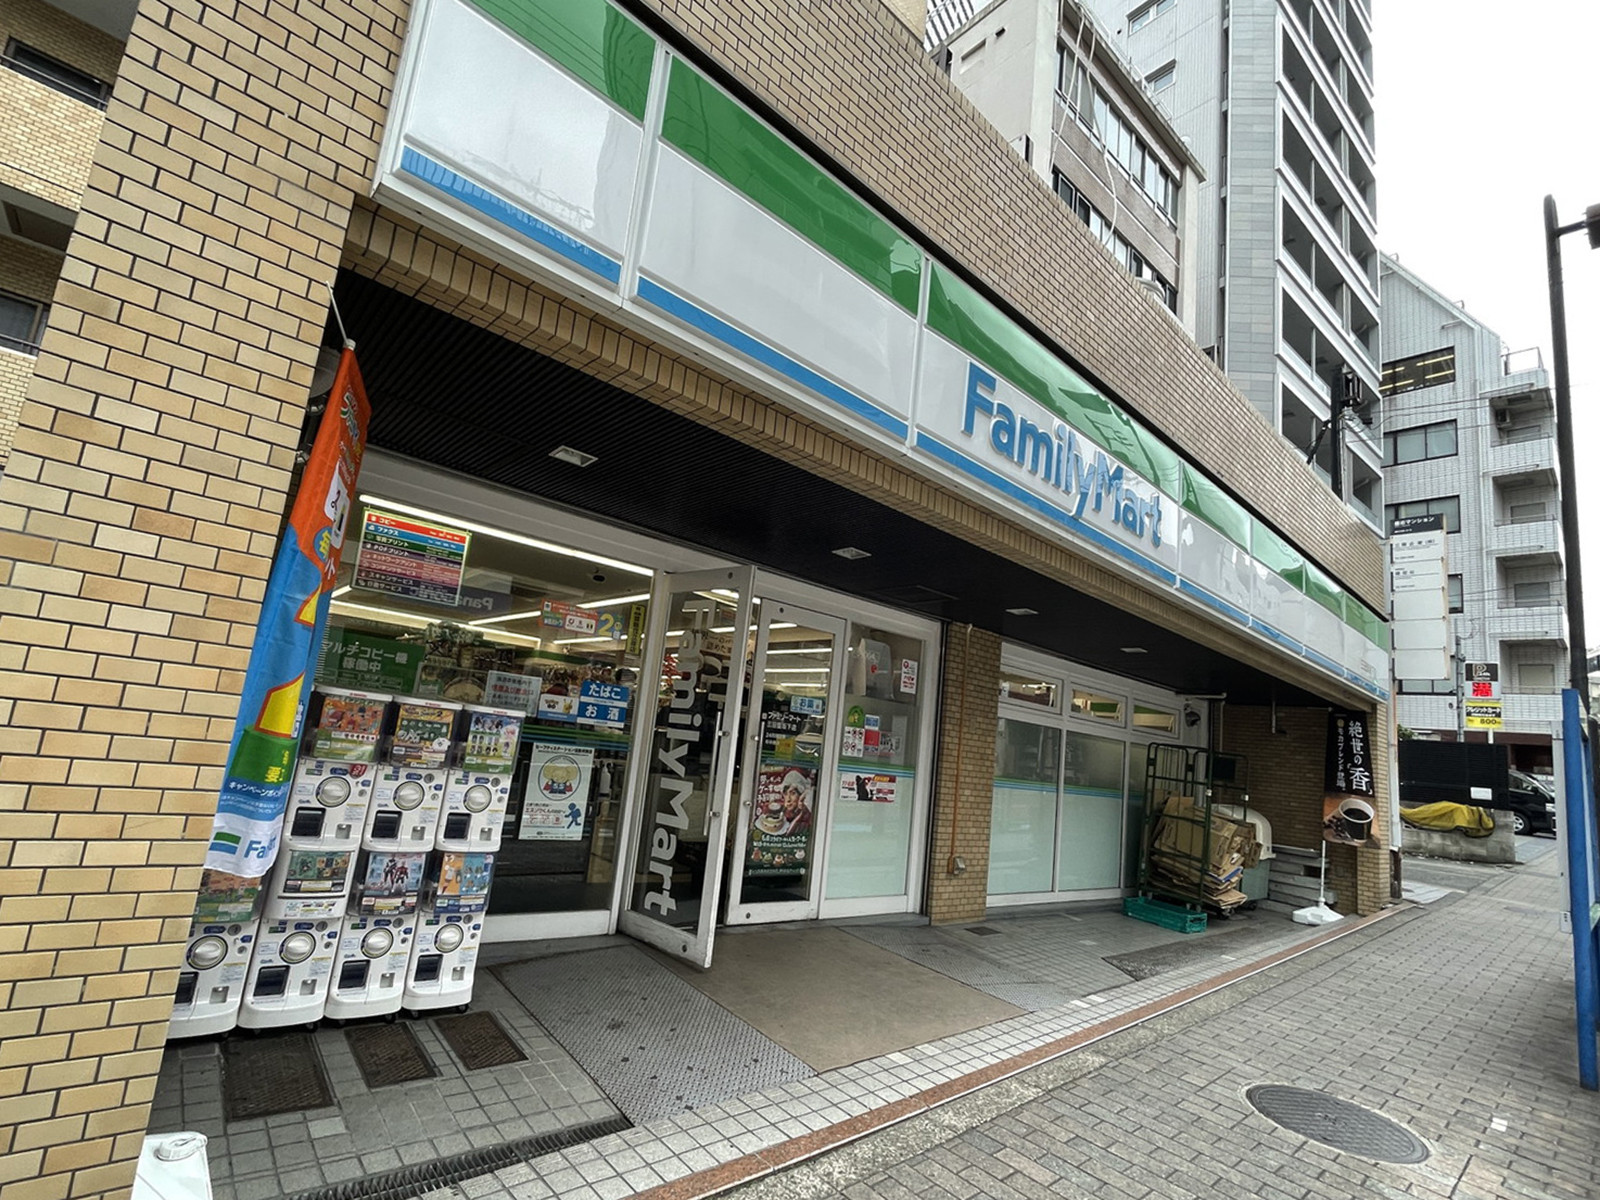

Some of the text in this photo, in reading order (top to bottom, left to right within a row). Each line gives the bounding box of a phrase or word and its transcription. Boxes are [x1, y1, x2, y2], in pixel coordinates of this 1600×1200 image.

[960, 359, 1162, 548] FamilyMart
[589, 683, 622, 700] たばこ
[1472, 681, 1493, 697] 満
[643, 599, 717, 917] FamilyMart
